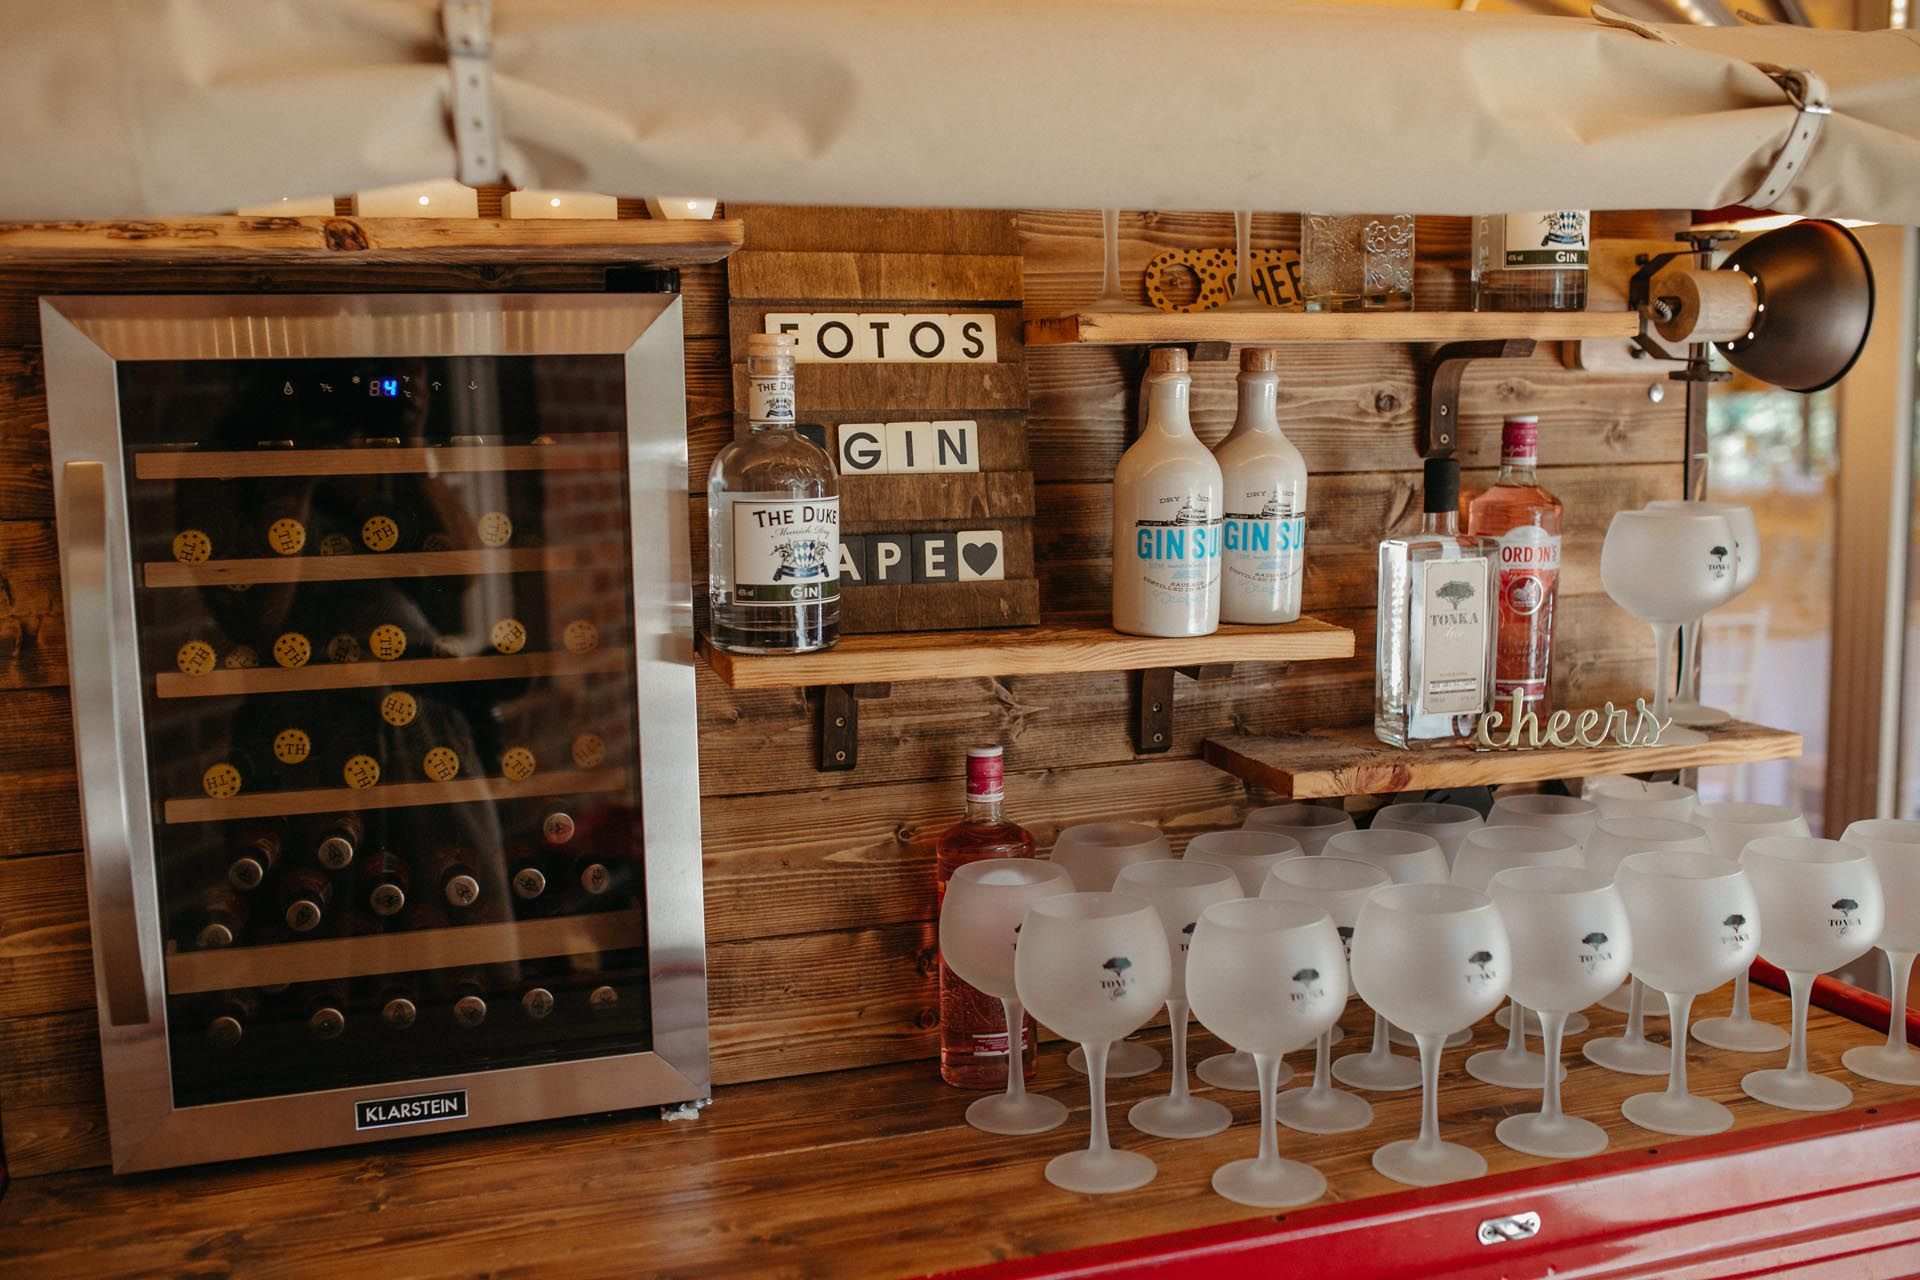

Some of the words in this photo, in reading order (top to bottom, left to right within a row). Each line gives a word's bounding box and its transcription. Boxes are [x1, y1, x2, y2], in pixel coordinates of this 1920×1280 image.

[1555, 251, 1578, 263] GIN
[384, 380, 397, 396] 4
[757, 383, 777, 393] THE
[843, 428, 969, 471] GIN
[752, 509, 795, 529] THE
[802, 505, 838, 525] DUKE
[278, 530, 295, 552] TH
[373, 524, 395, 543] TH
[1137, 528, 1185, 560] GIN
[1223, 520, 1270, 552] GIN
[180, 541, 197, 563] TH
[838, 539, 946, 581] APE
[790, 586, 819, 599] GIN
[1429, 612, 1480, 626] TONKA
[379, 636, 393, 657] TH
[503, 626, 523, 646] TH
[189, 647, 211, 668] TH
[284, 644, 304, 667] TH
[384, 697, 405, 715] TH
[1476, 687, 1673, 747] cheers
[285, 743, 307, 756] TH
[353, 767, 372, 790] TH
[433, 758, 452, 780] TH
[511, 759, 531, 779] TH
[206, 773, 229, 791] TH
[365, 1097, 459, 1123] KLARSTEIN
